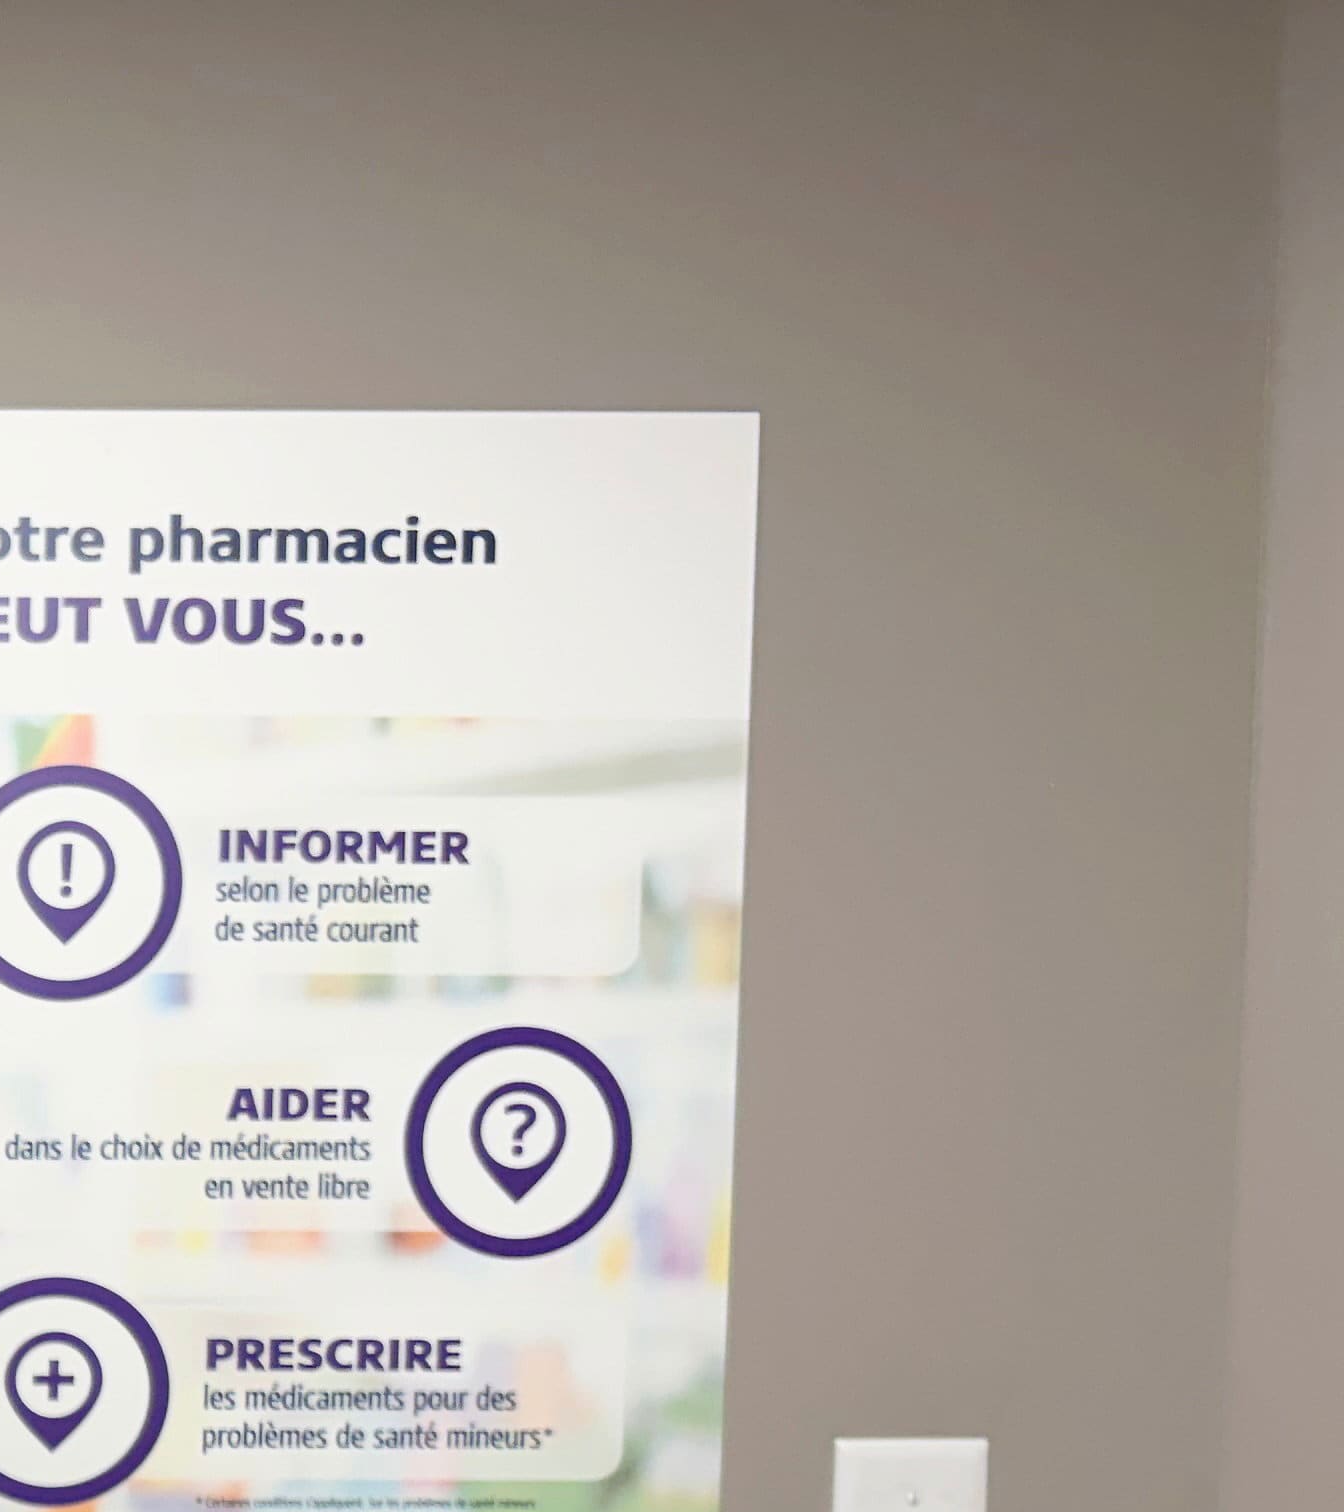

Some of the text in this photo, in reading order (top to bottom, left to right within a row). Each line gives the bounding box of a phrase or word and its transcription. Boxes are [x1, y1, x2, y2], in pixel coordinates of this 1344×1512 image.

[129, 513, 497, 574] pharmacien
[219, 828, 469, 865] INFORMER
[215, 874, 431, 909] selon le problème
[214, 914, 420, 943] de santé courant
[227, 1087, 371, 1122] AIDER
[4, 1132, 371, 1161] dans le choix de médicaments
[204, 1172, 370, 1200] en vente libre
[206, 1338, 462, 1372] PRESCRIRE
[203, 1383, 517, 1417] les médicaments pour des
[201, 1421, 328, 1454] problèmes
[335, 1422, 365, 1449] de
[373, 1421, 438, 1450] santé
